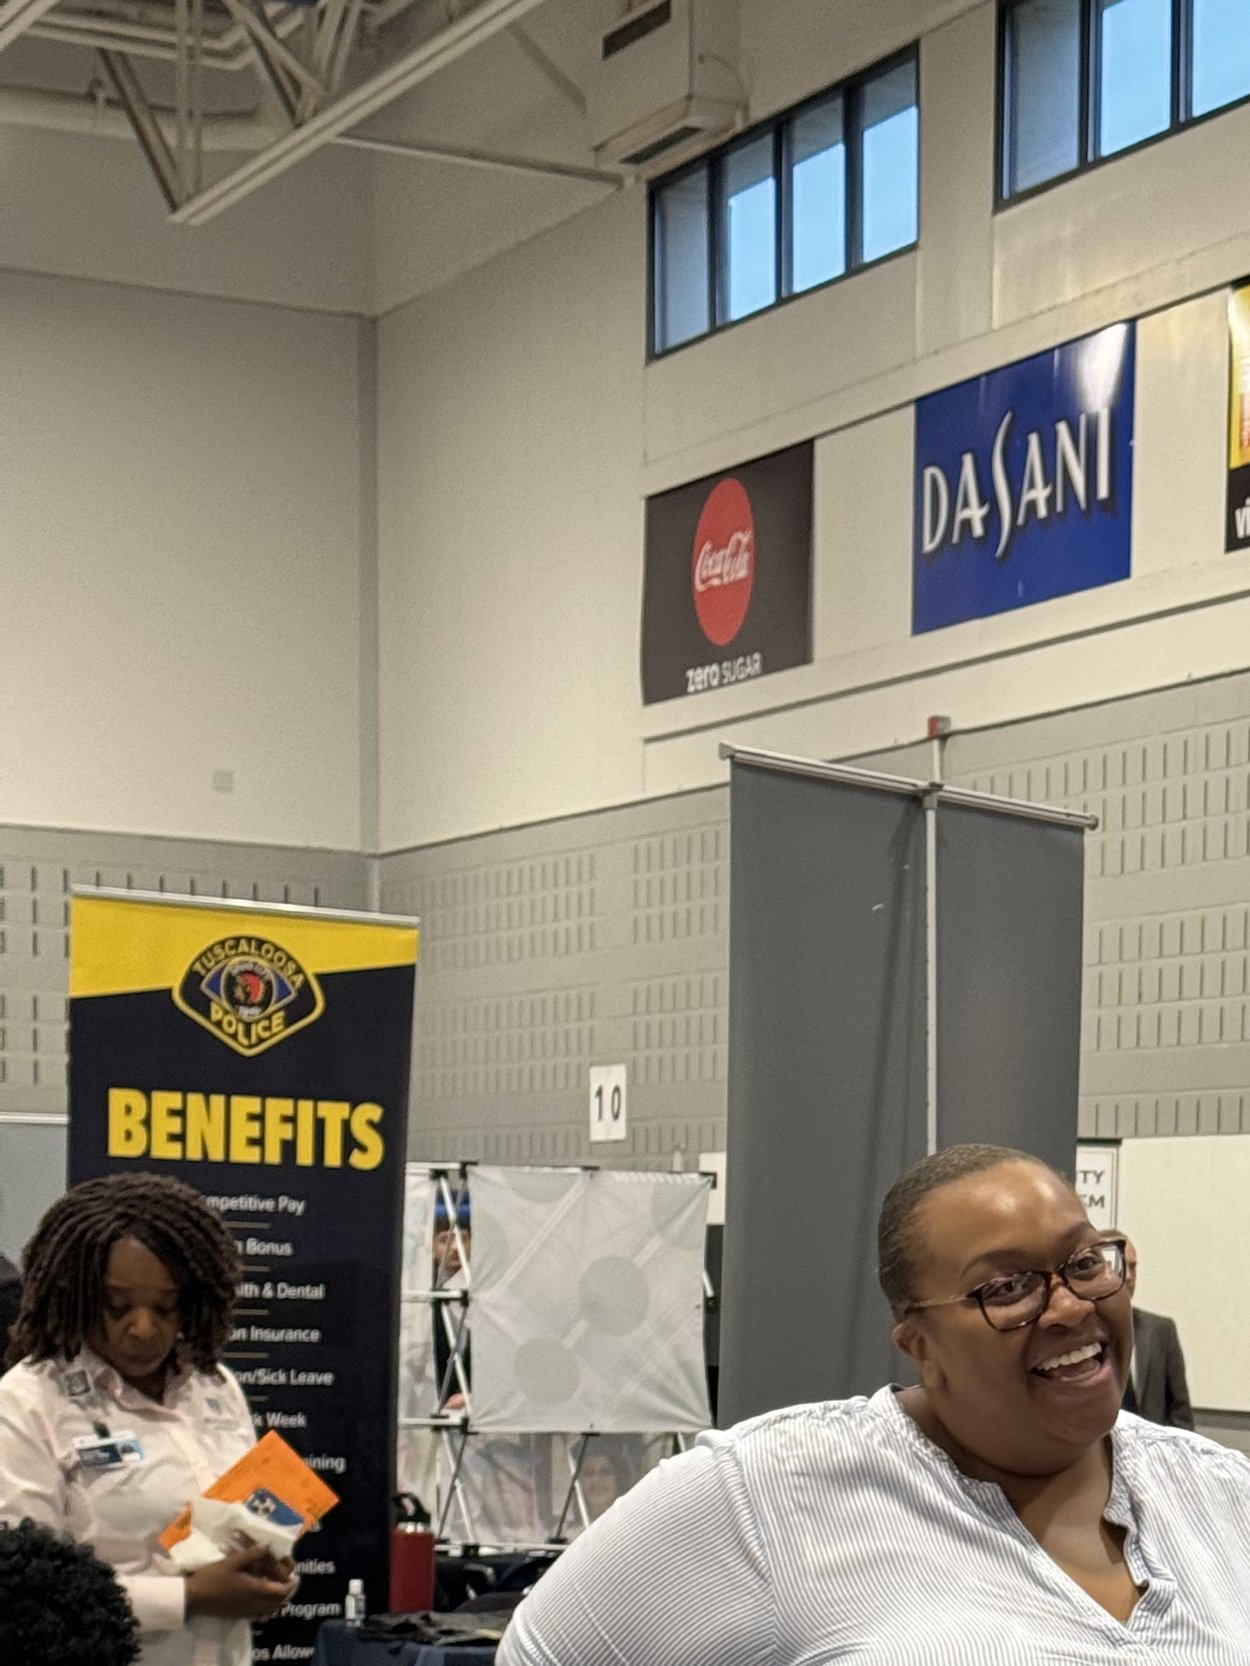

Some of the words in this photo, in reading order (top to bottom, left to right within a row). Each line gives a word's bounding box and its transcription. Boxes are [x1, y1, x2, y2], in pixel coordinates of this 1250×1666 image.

[922, 408, 1109, 558] DASANI
[686, 662, 720, 693] zero
[721, 652, 763, 685] SUGAR
[193, 938, 304, 990] TUSCALOOSA
[210, 1002, 285, 1045] POLICE
[108, 1088, 384, 1171] BENEFITS
[205, 1194, 275, 1214] mpetitive
[278, 1196, 306, 1216] Pay
[245, 1237, 294, 1256] Bonus
[262, 1282, 274, 1299] &
[277, 1282, 326, 1300] Dental
[251, 1325, 321, 1343] Insurance
[236, 1368, 287, 1386] on/Sick
[290, 1369, 334, 1386] Leave
[266, 1412, 307, 1427] Week
[281, 1602, 340, 1620] Program
[272, 1644, 315, 1660] Allow
